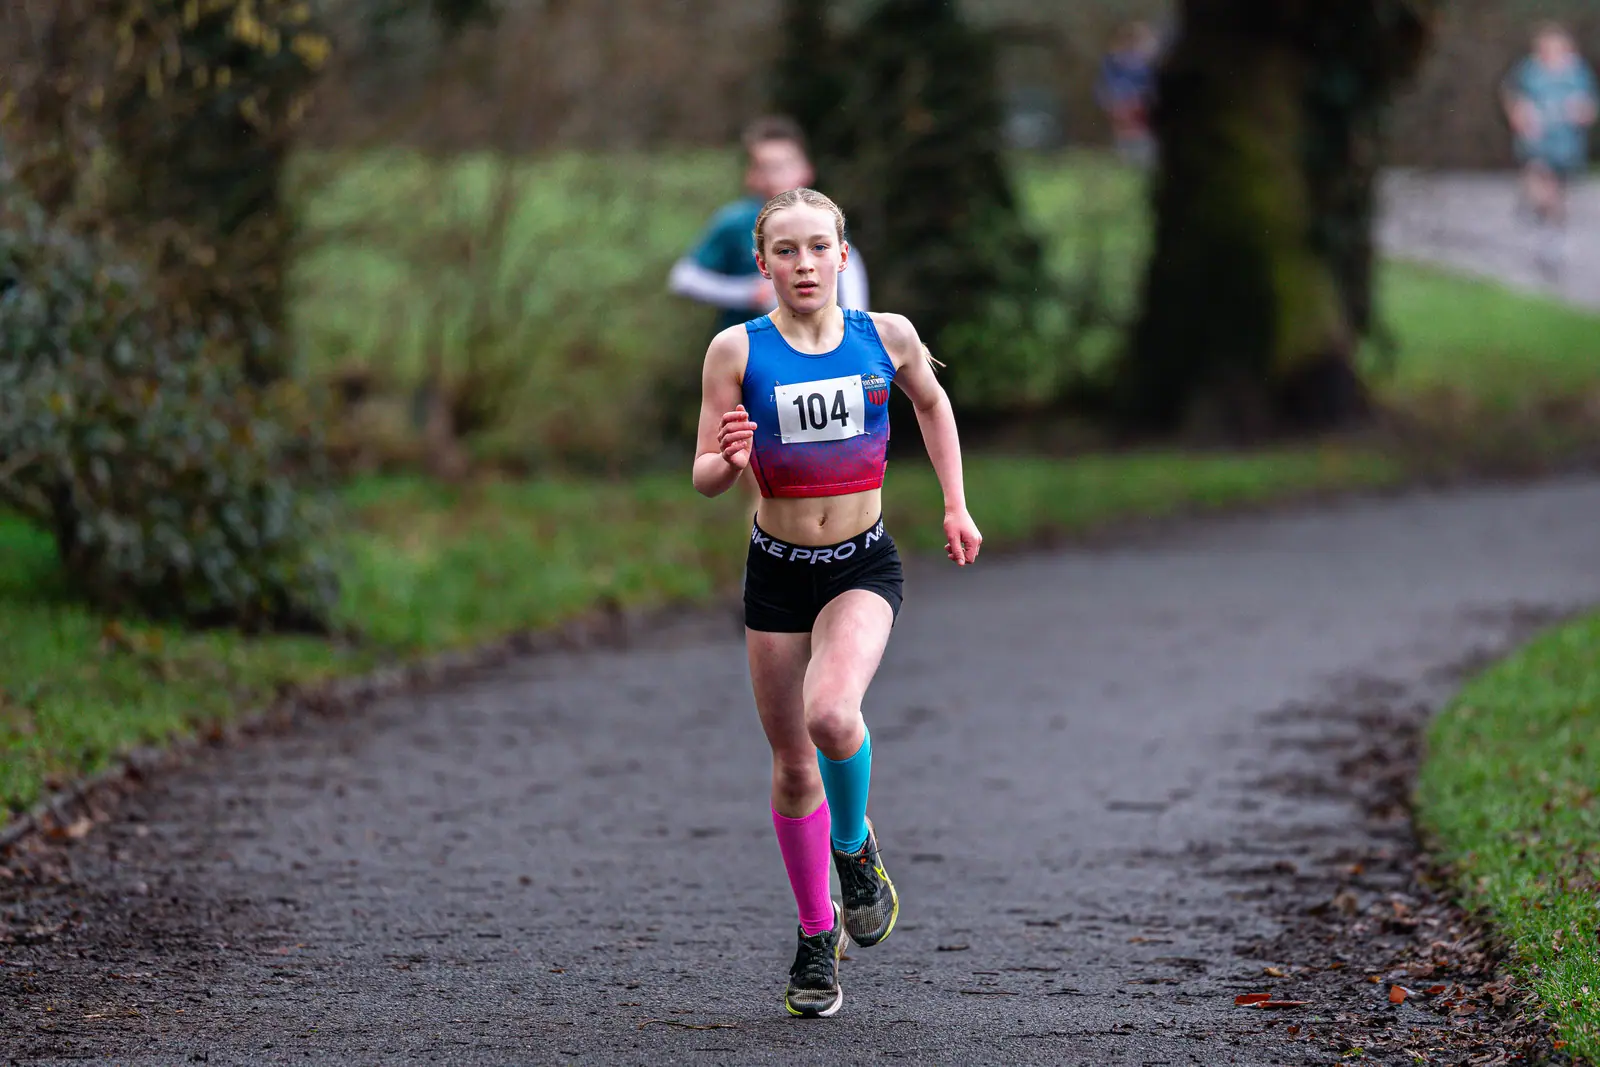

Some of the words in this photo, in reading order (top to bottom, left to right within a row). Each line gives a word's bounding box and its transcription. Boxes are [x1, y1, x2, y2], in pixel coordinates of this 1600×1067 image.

[792, 389, 849, 431] 104
[752, 524, 787, 558] IKE
[788, 542, 857, 564] PRO
